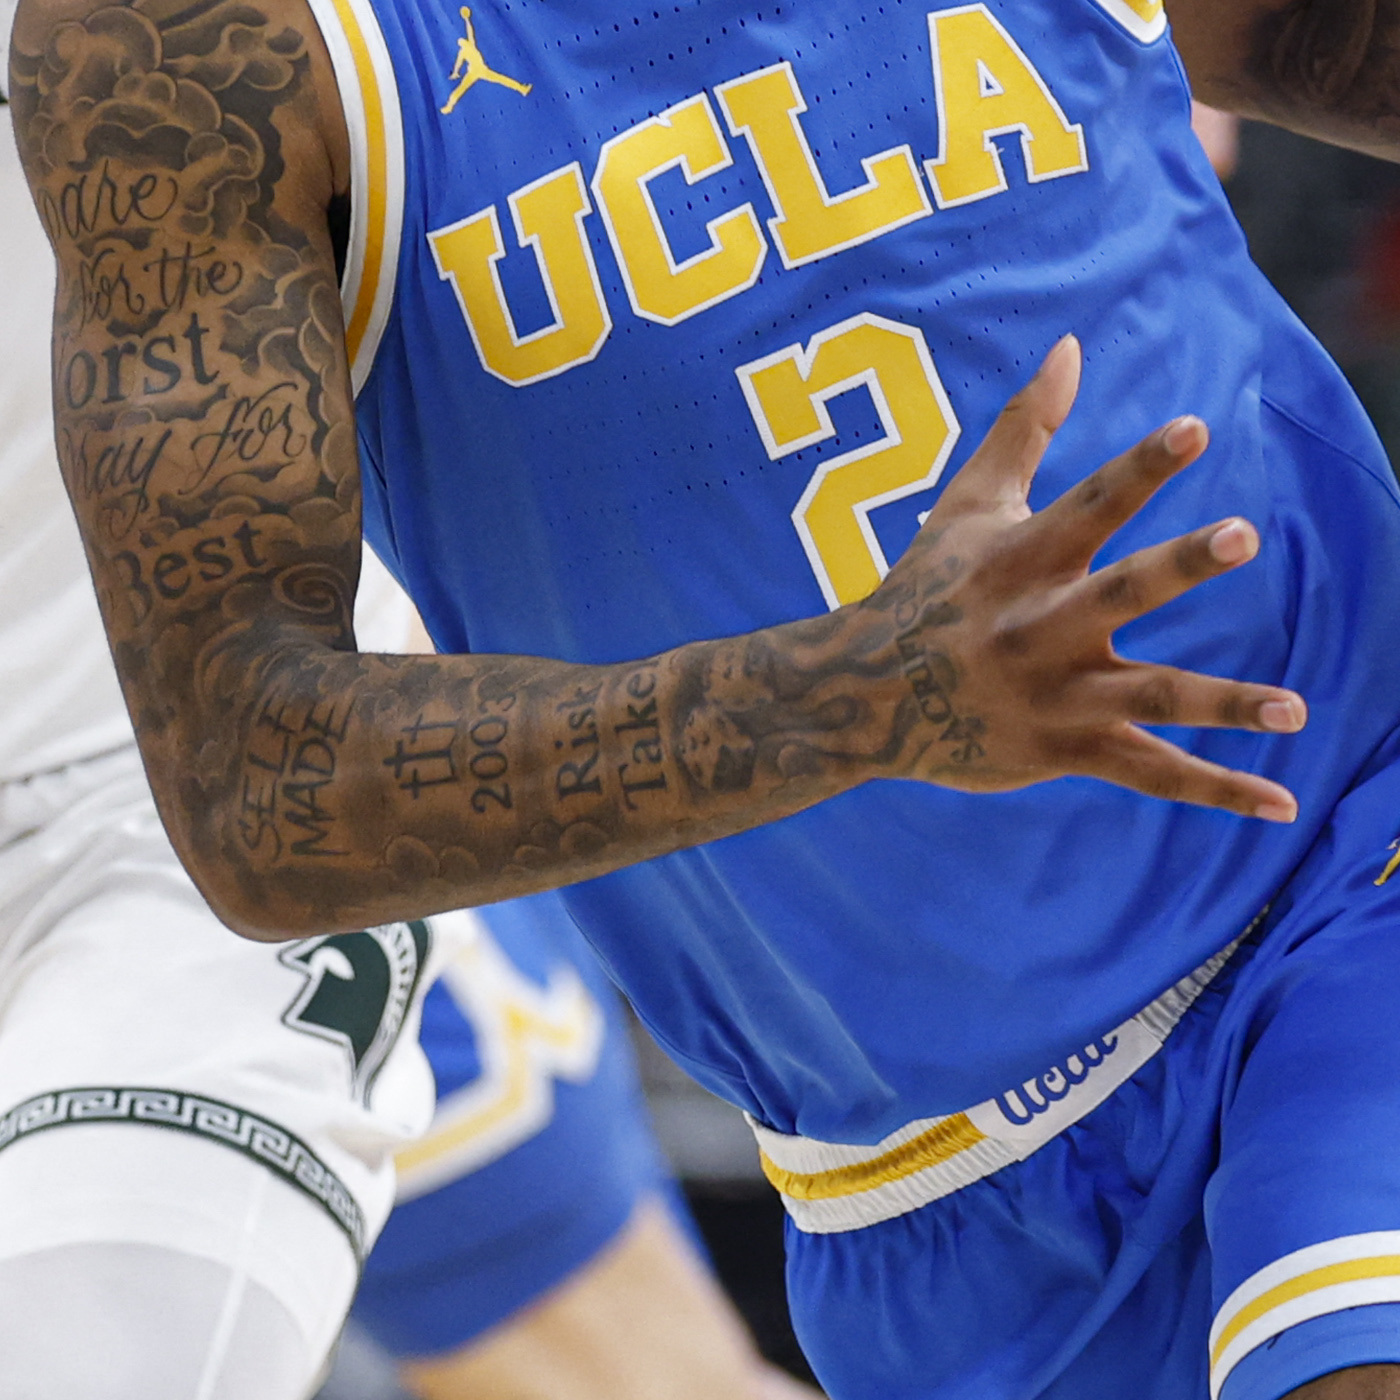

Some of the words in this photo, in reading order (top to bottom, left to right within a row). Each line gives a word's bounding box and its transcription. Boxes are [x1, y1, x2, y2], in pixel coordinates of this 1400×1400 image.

[426, 2, 1089, 389] UCLA
[143, 241, 243, 313] the
[59, 312, 220, 410] orst
[177, 381, 307, 496] for
[735, 311, 962, 611] 2
[237, 685, 297, 864] SELF
[281, 694, 357, 858] MADE
[470, 693, 517, 815] 2003
[556, 680, 603, 802] Risk
